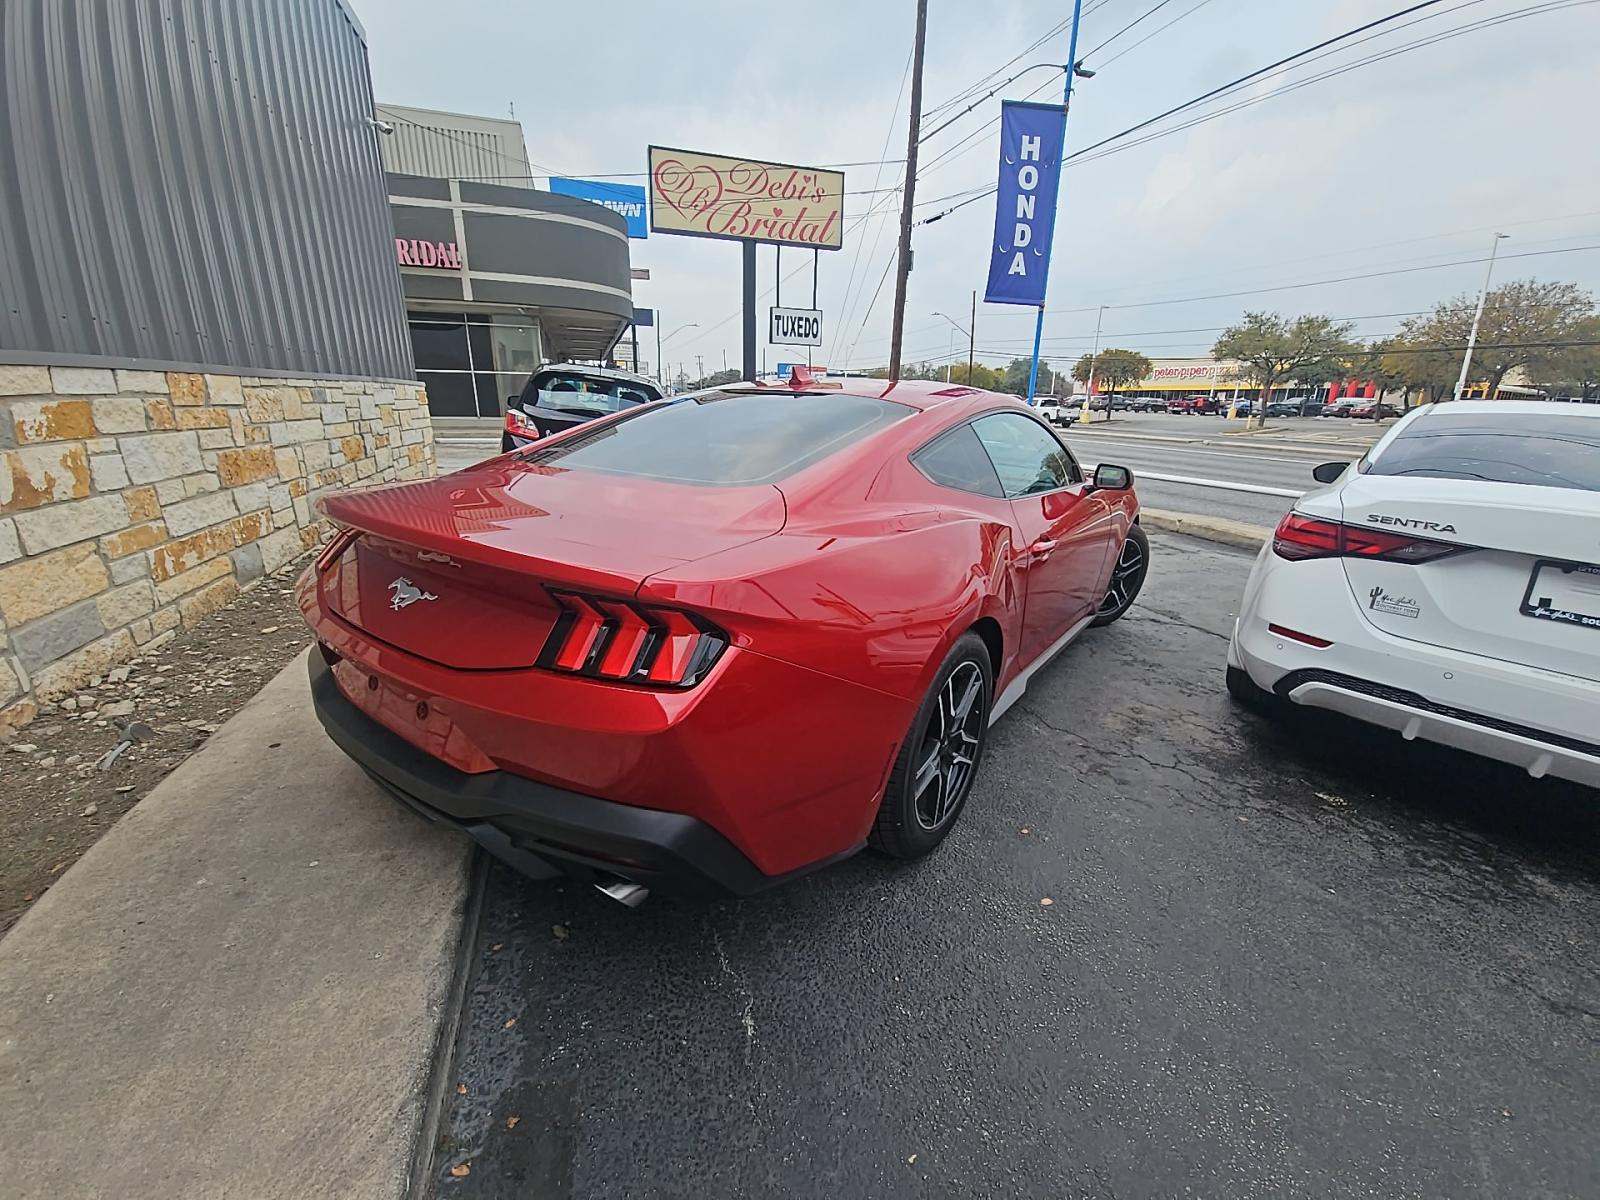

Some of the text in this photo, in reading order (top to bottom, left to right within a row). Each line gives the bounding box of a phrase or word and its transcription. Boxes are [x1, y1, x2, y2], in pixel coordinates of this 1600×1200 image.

[725, 162, 826, 203] Debi's
[706, 200, 838, 243] Bridal
[1008, 135, 1041, 276] HONDA
[775, 315, 819, 338] TUXEDO
[1367, 514, 1457, 534] SENTRA
